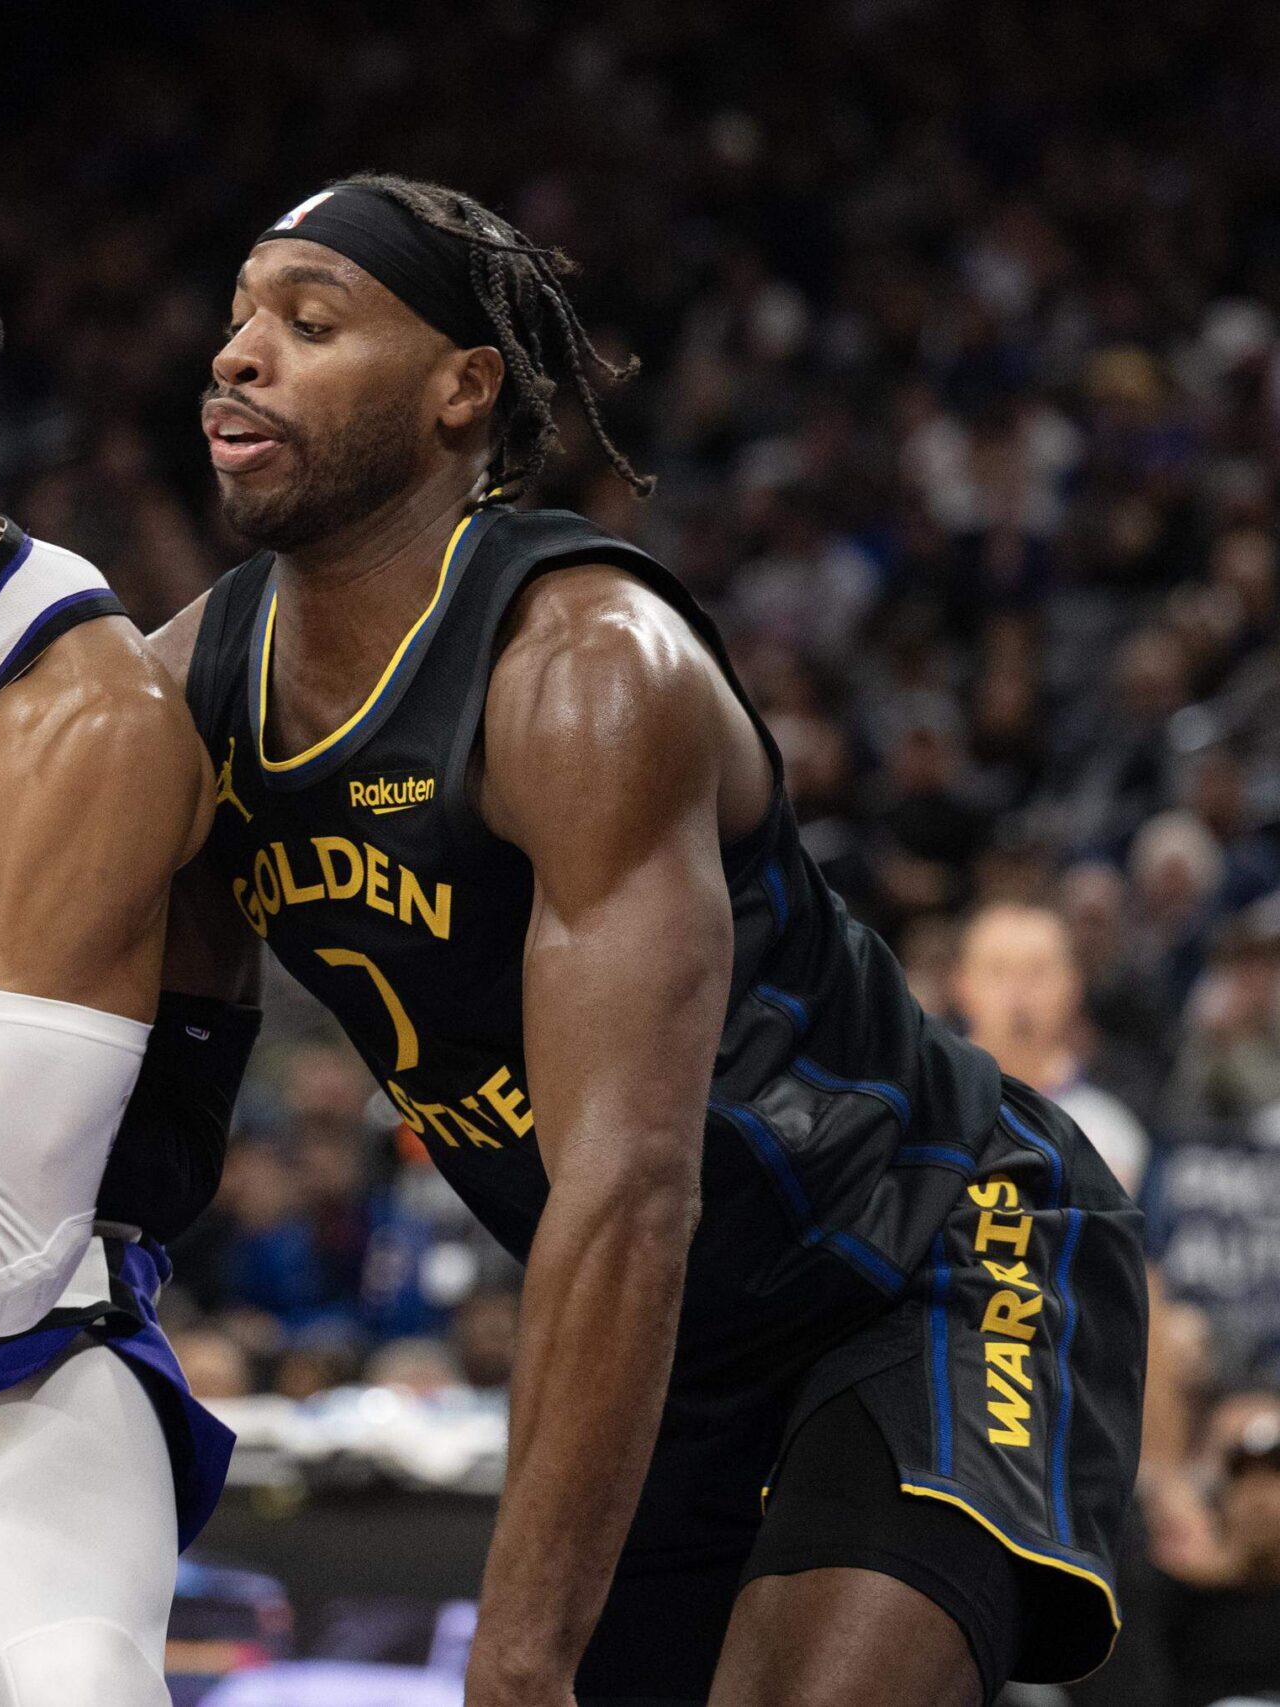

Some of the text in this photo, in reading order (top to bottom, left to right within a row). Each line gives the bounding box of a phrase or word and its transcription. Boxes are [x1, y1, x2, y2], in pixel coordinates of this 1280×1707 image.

[349, 775, 436, 808] Rakuten
[231, 835, 453, 940] GOLDEN
[313, 947, 419, 1073] 7
[966, 1173, 1044, 1449] WARRIS
